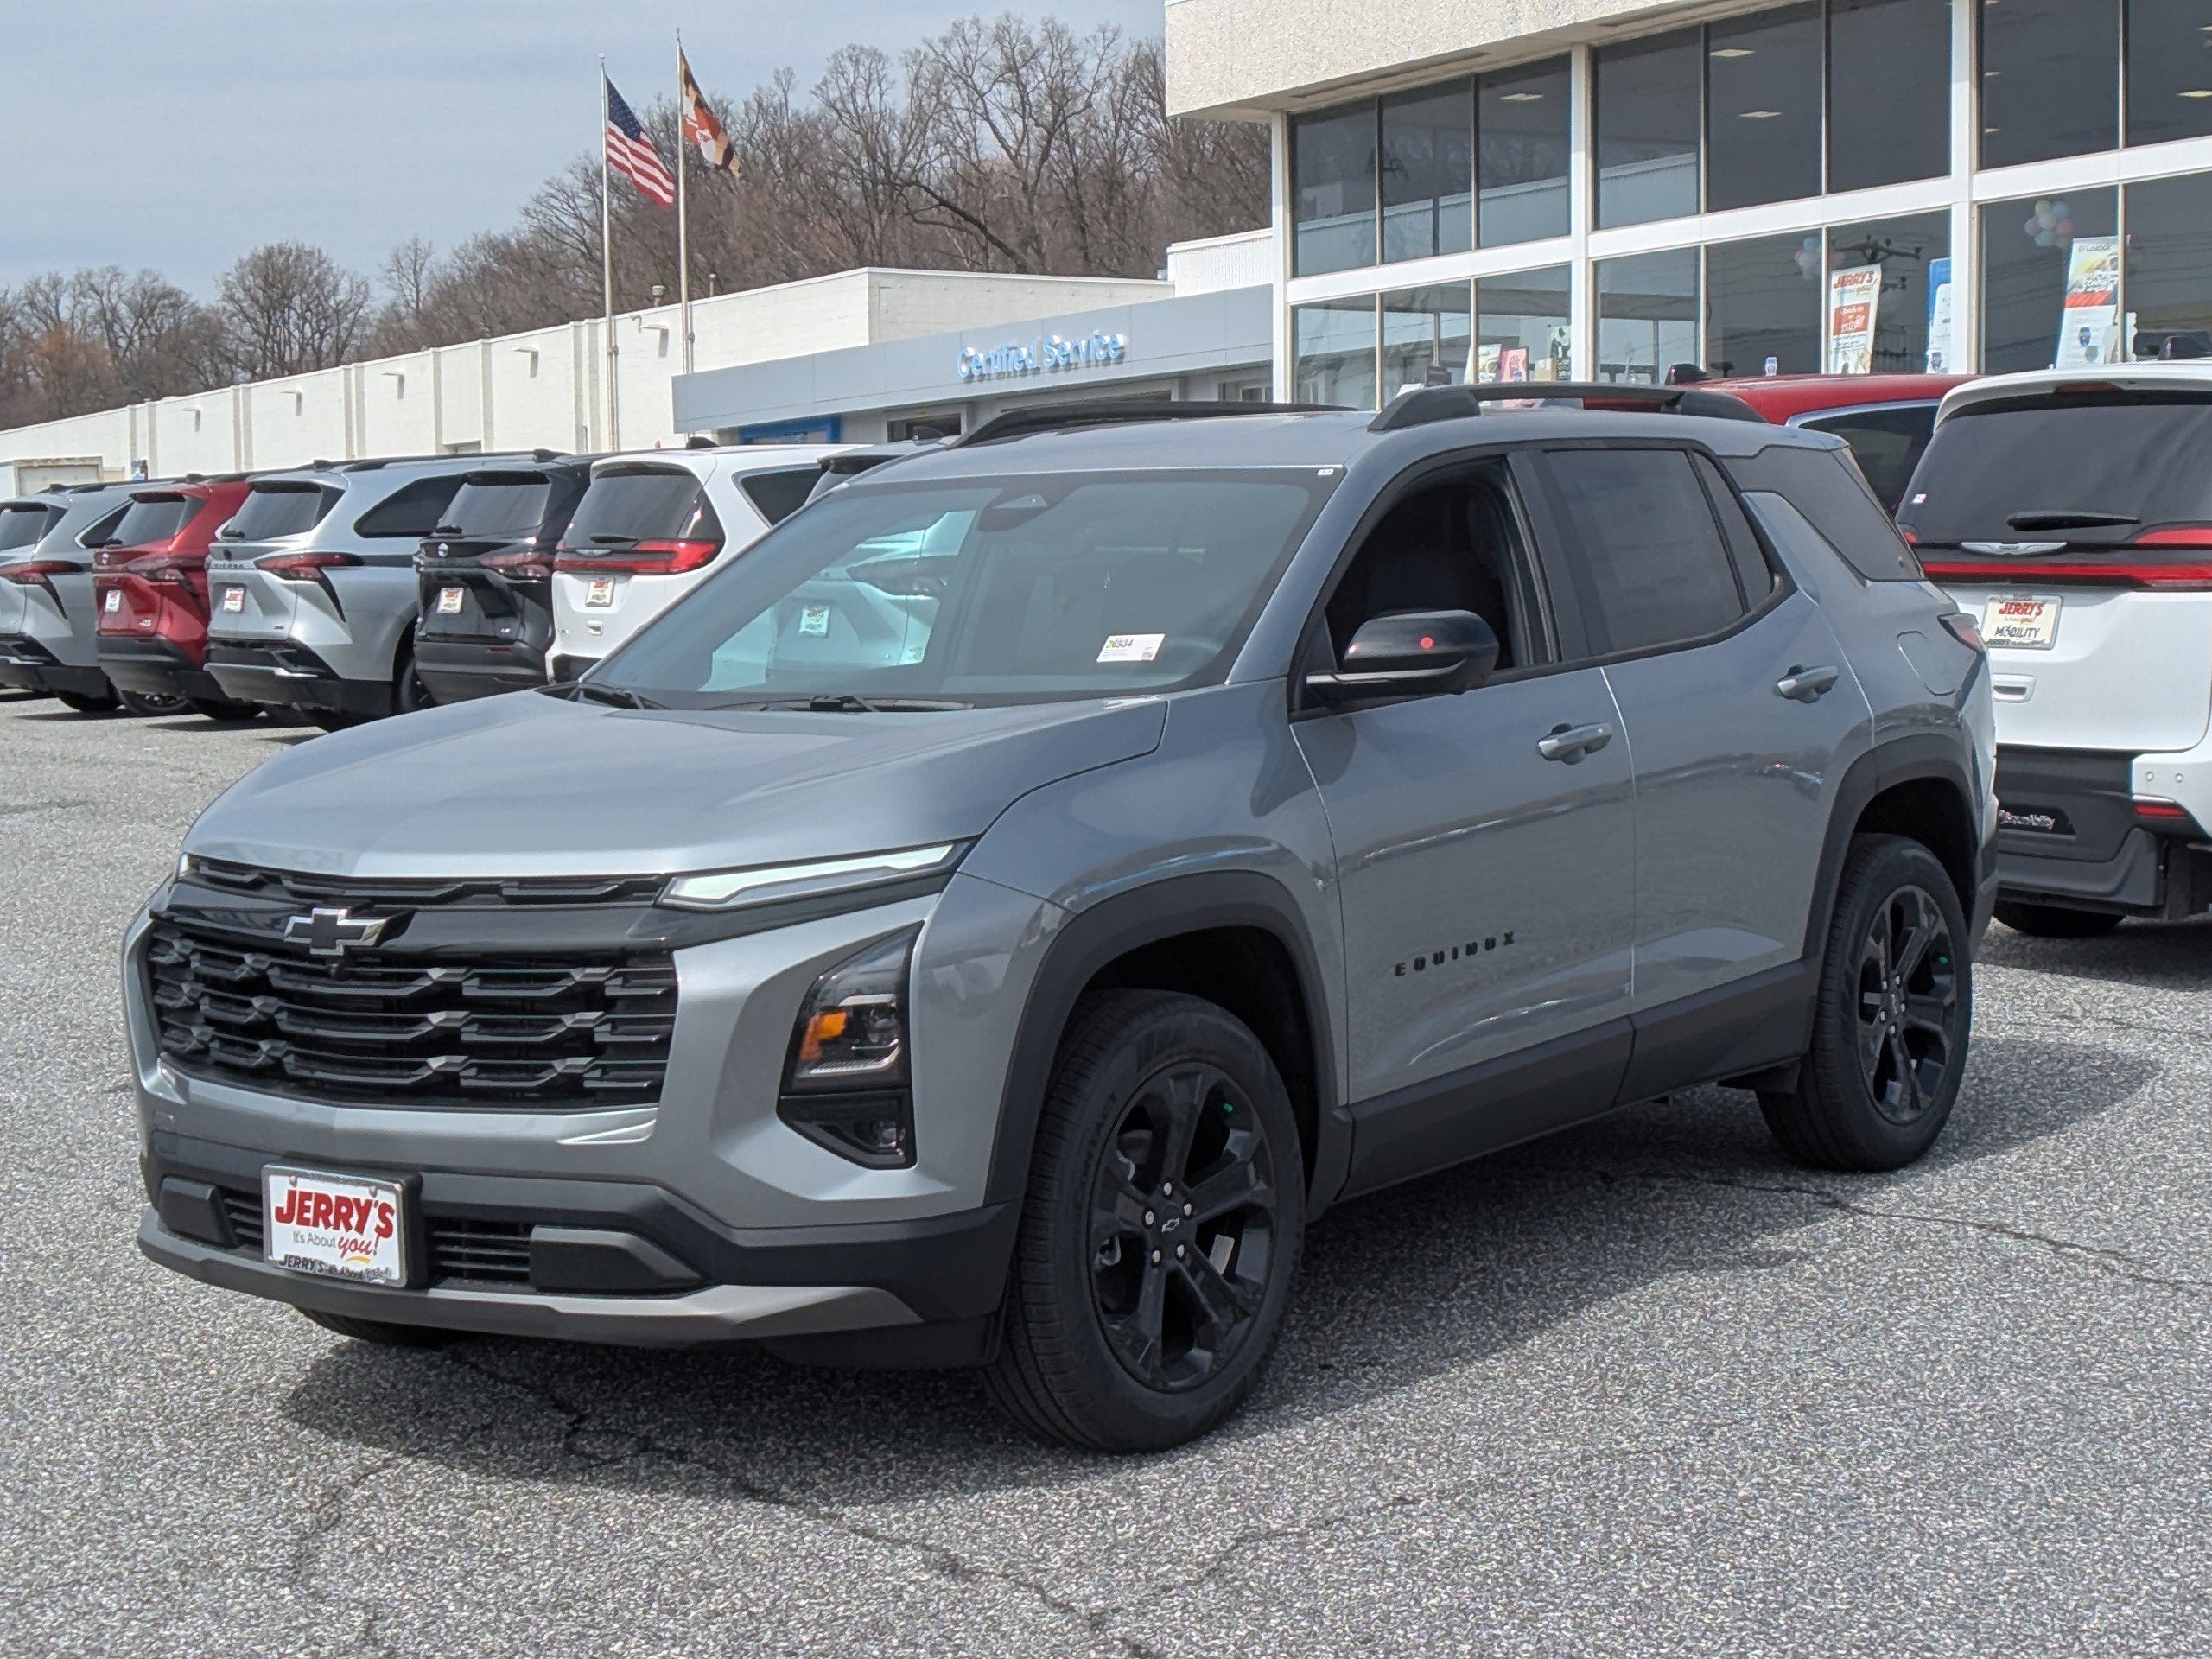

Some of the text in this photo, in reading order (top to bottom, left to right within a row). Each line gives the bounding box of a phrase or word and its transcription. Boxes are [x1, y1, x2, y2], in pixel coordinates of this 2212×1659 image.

[1834, 270, 1875, 289] JERRY'S
[957, 329, 1125, 378] Certified Service
[1999, 601, 2045, 616] JERRY'S
[1395, 931, 1515, 977] EQUINOX
[275, 1189, 396, 1239] JERRY'S
[292, 1230, 379, 1259] It's About you!
